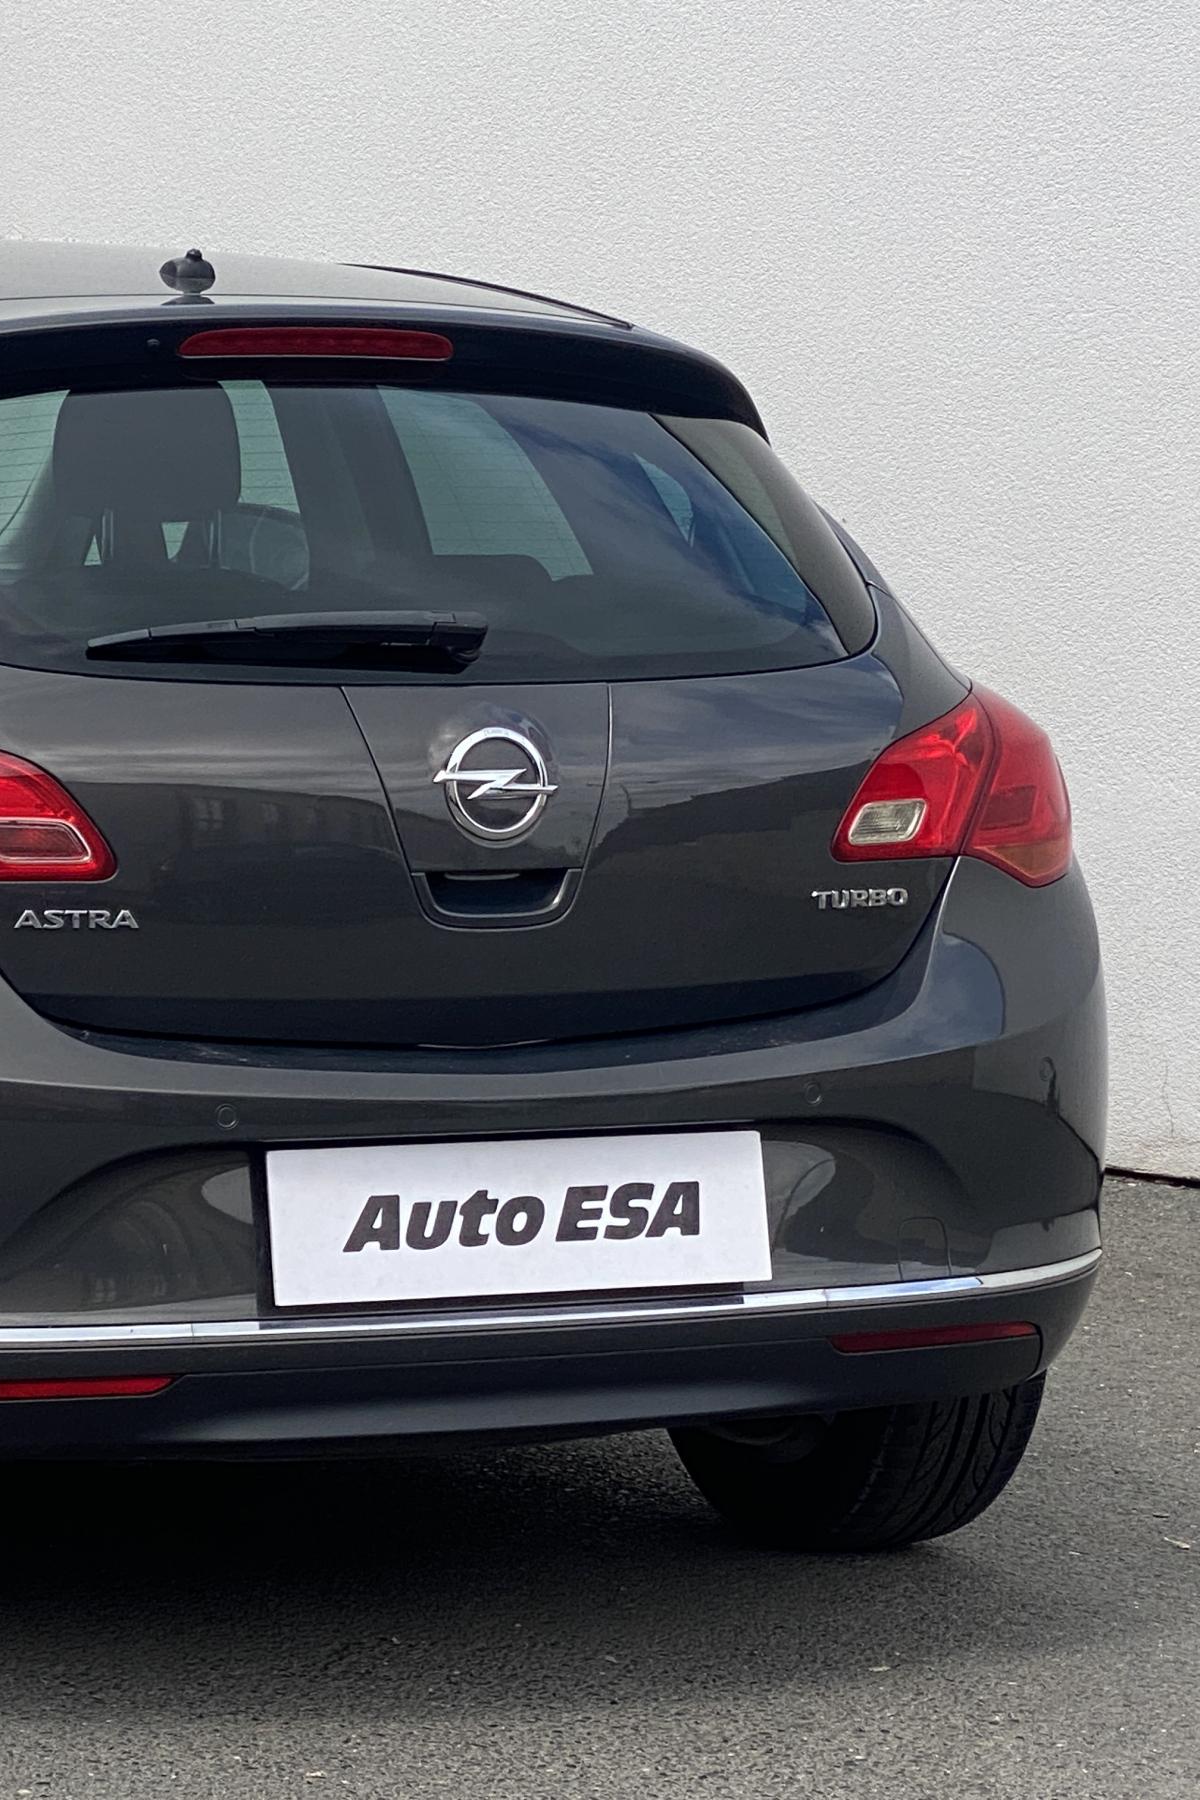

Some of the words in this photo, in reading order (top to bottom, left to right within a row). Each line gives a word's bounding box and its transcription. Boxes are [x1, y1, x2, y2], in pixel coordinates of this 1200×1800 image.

[811, 887, 908, 910] TURBO
[13, 909, 140, 929] ASTRA
[342, 1189, 546, 1253] Auto
[555, 1181, 700, 1242] ESA
